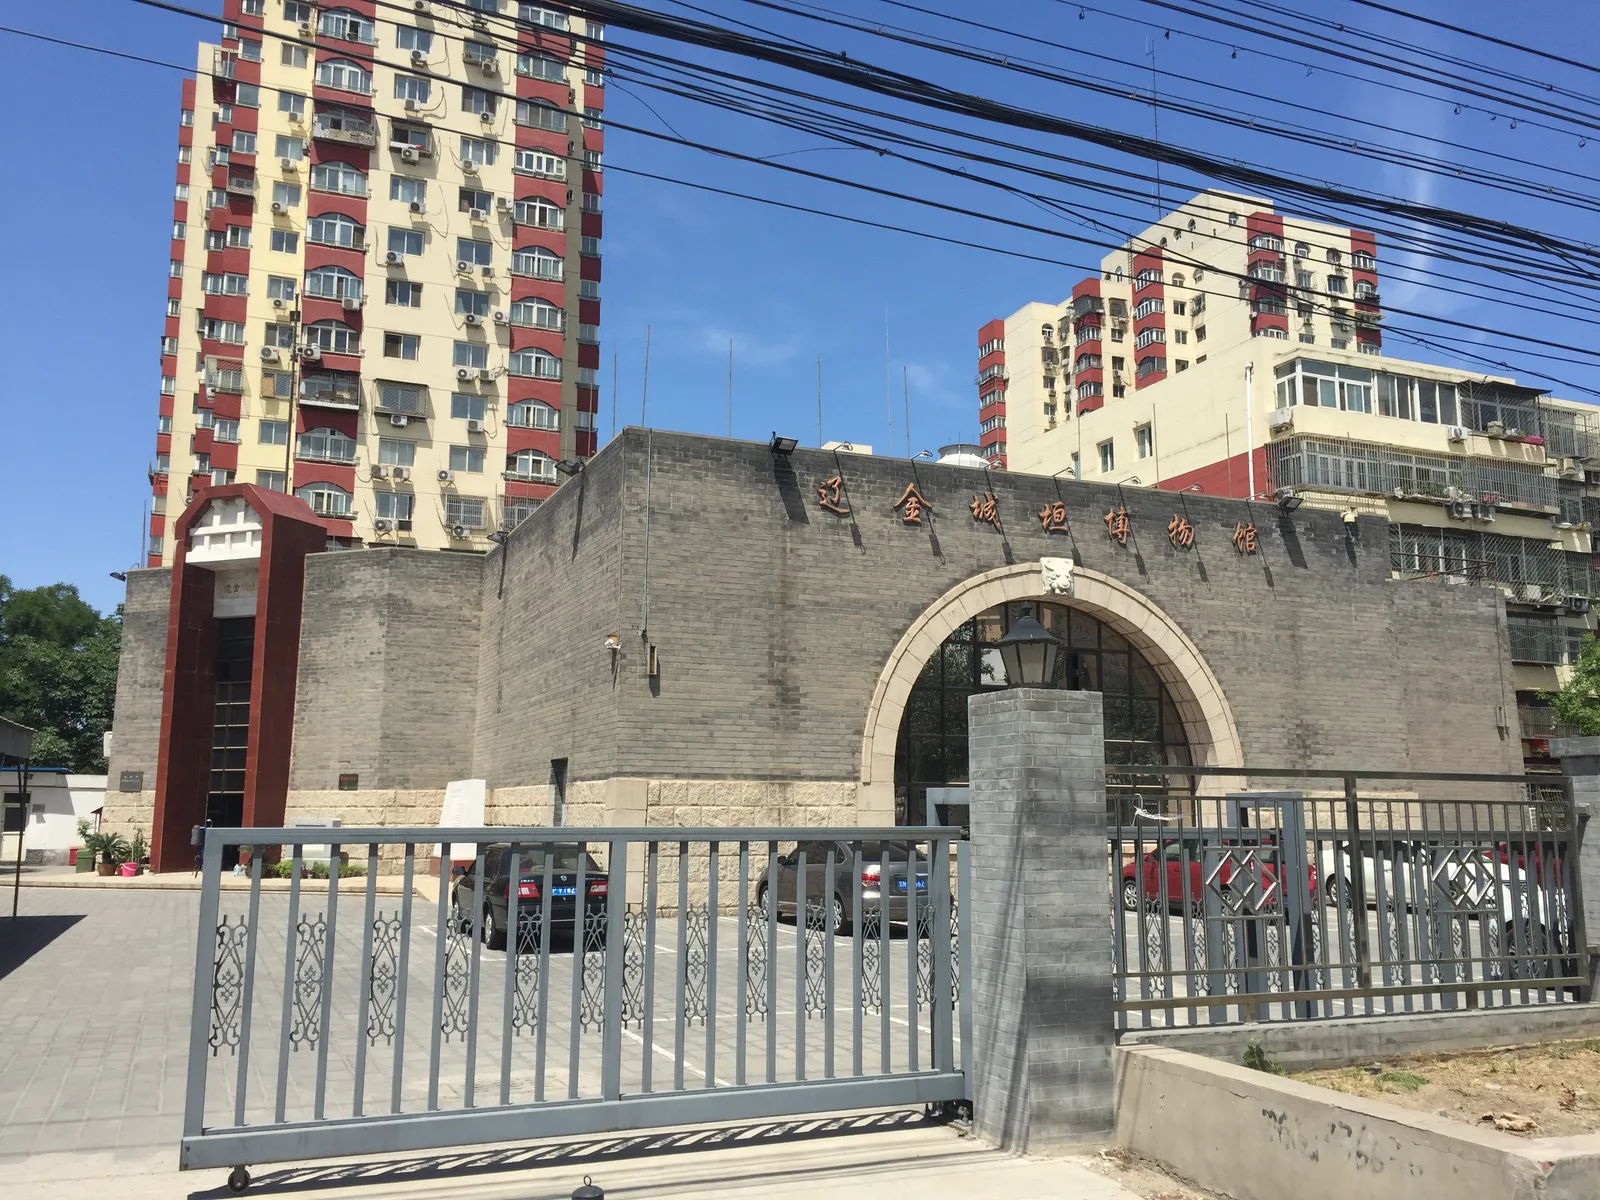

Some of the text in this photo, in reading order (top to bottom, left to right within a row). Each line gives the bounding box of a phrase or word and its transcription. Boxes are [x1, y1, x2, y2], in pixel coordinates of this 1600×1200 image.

[816, 475, 1259, 554] 辽金城垣博物馆
